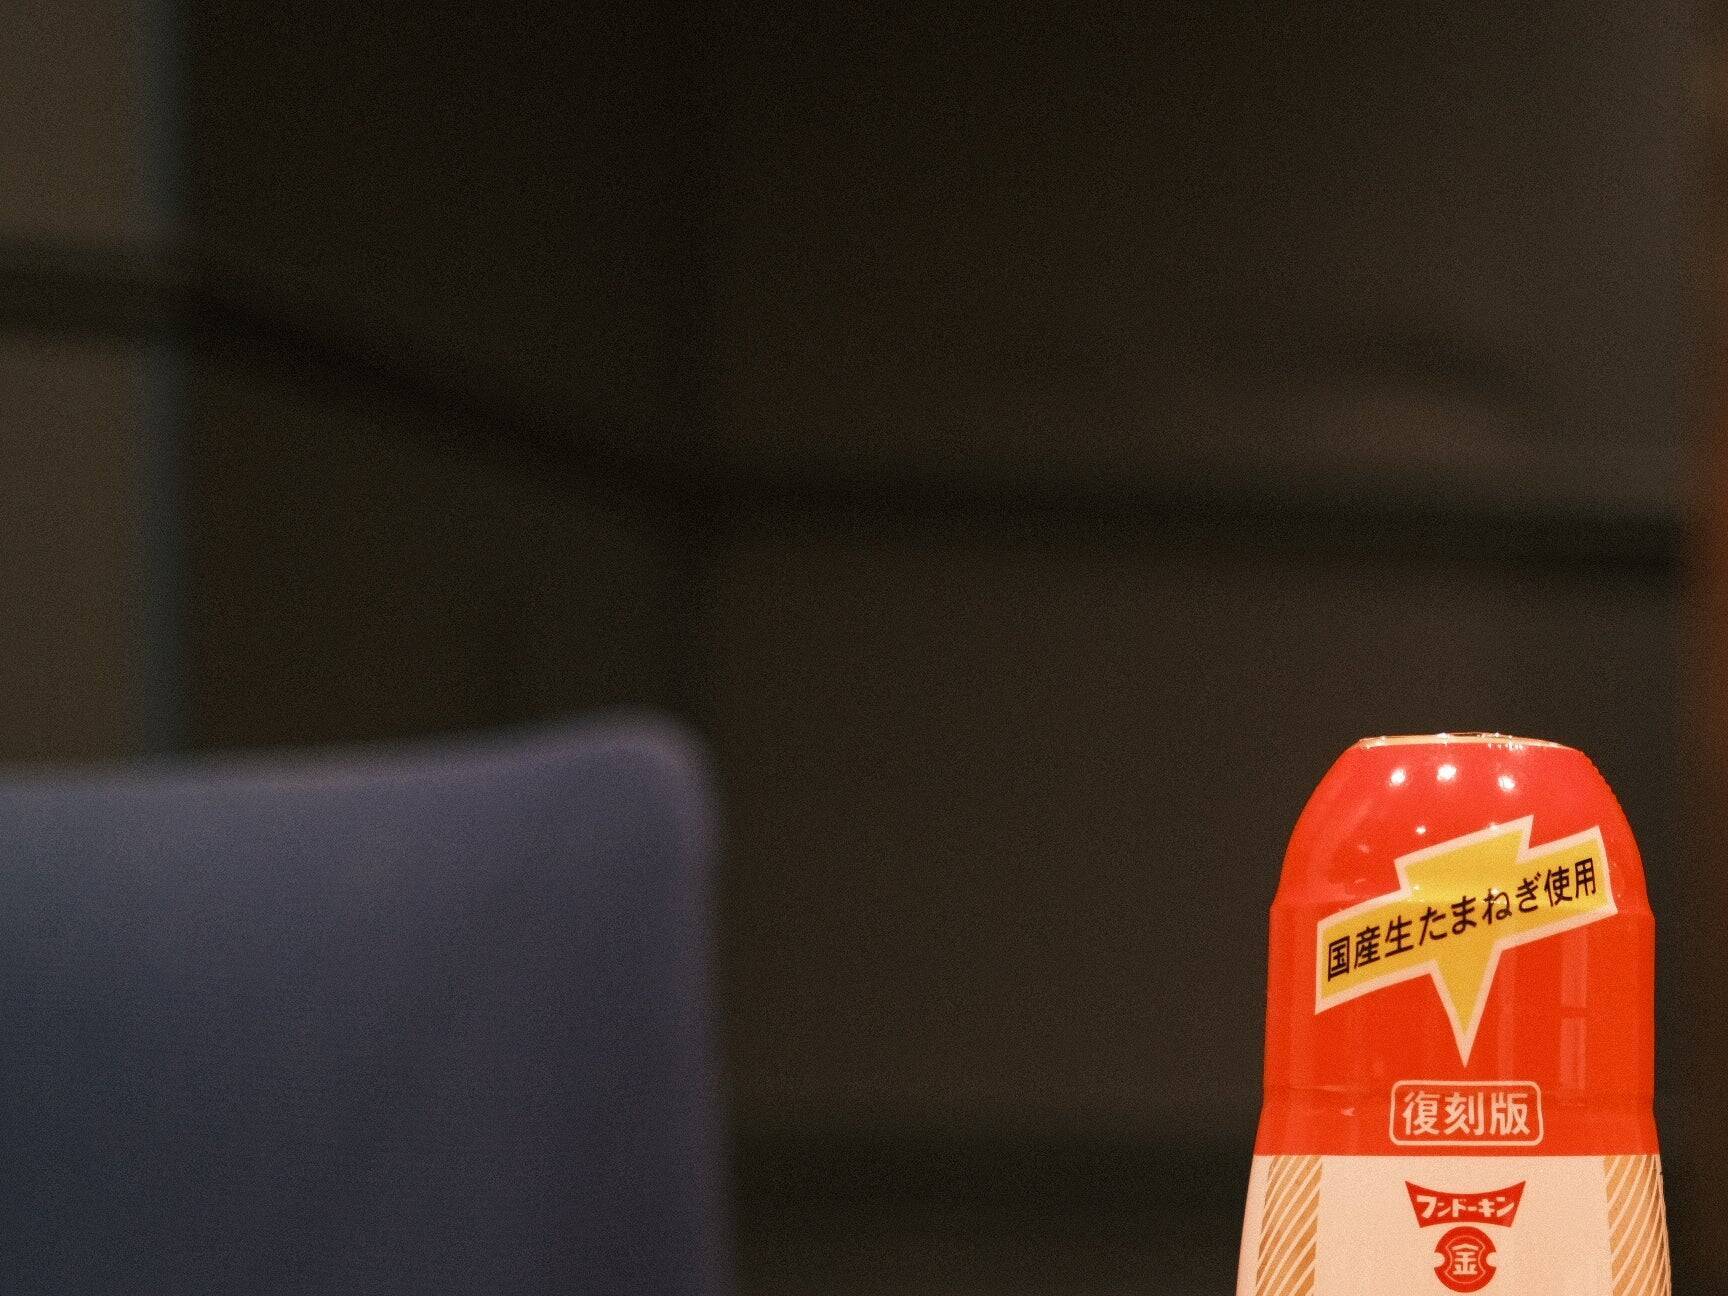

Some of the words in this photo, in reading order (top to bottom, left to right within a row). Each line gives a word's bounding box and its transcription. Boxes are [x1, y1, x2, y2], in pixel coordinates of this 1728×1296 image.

[1326, 857, 1598, 983] 国産生たまねぎ使用
[1402, 1092, 1531, 1137] 復刻版
[1416, 1194, 1515, 1219] フンドーキン
[1451, 1243, 1480, 1275] 金
